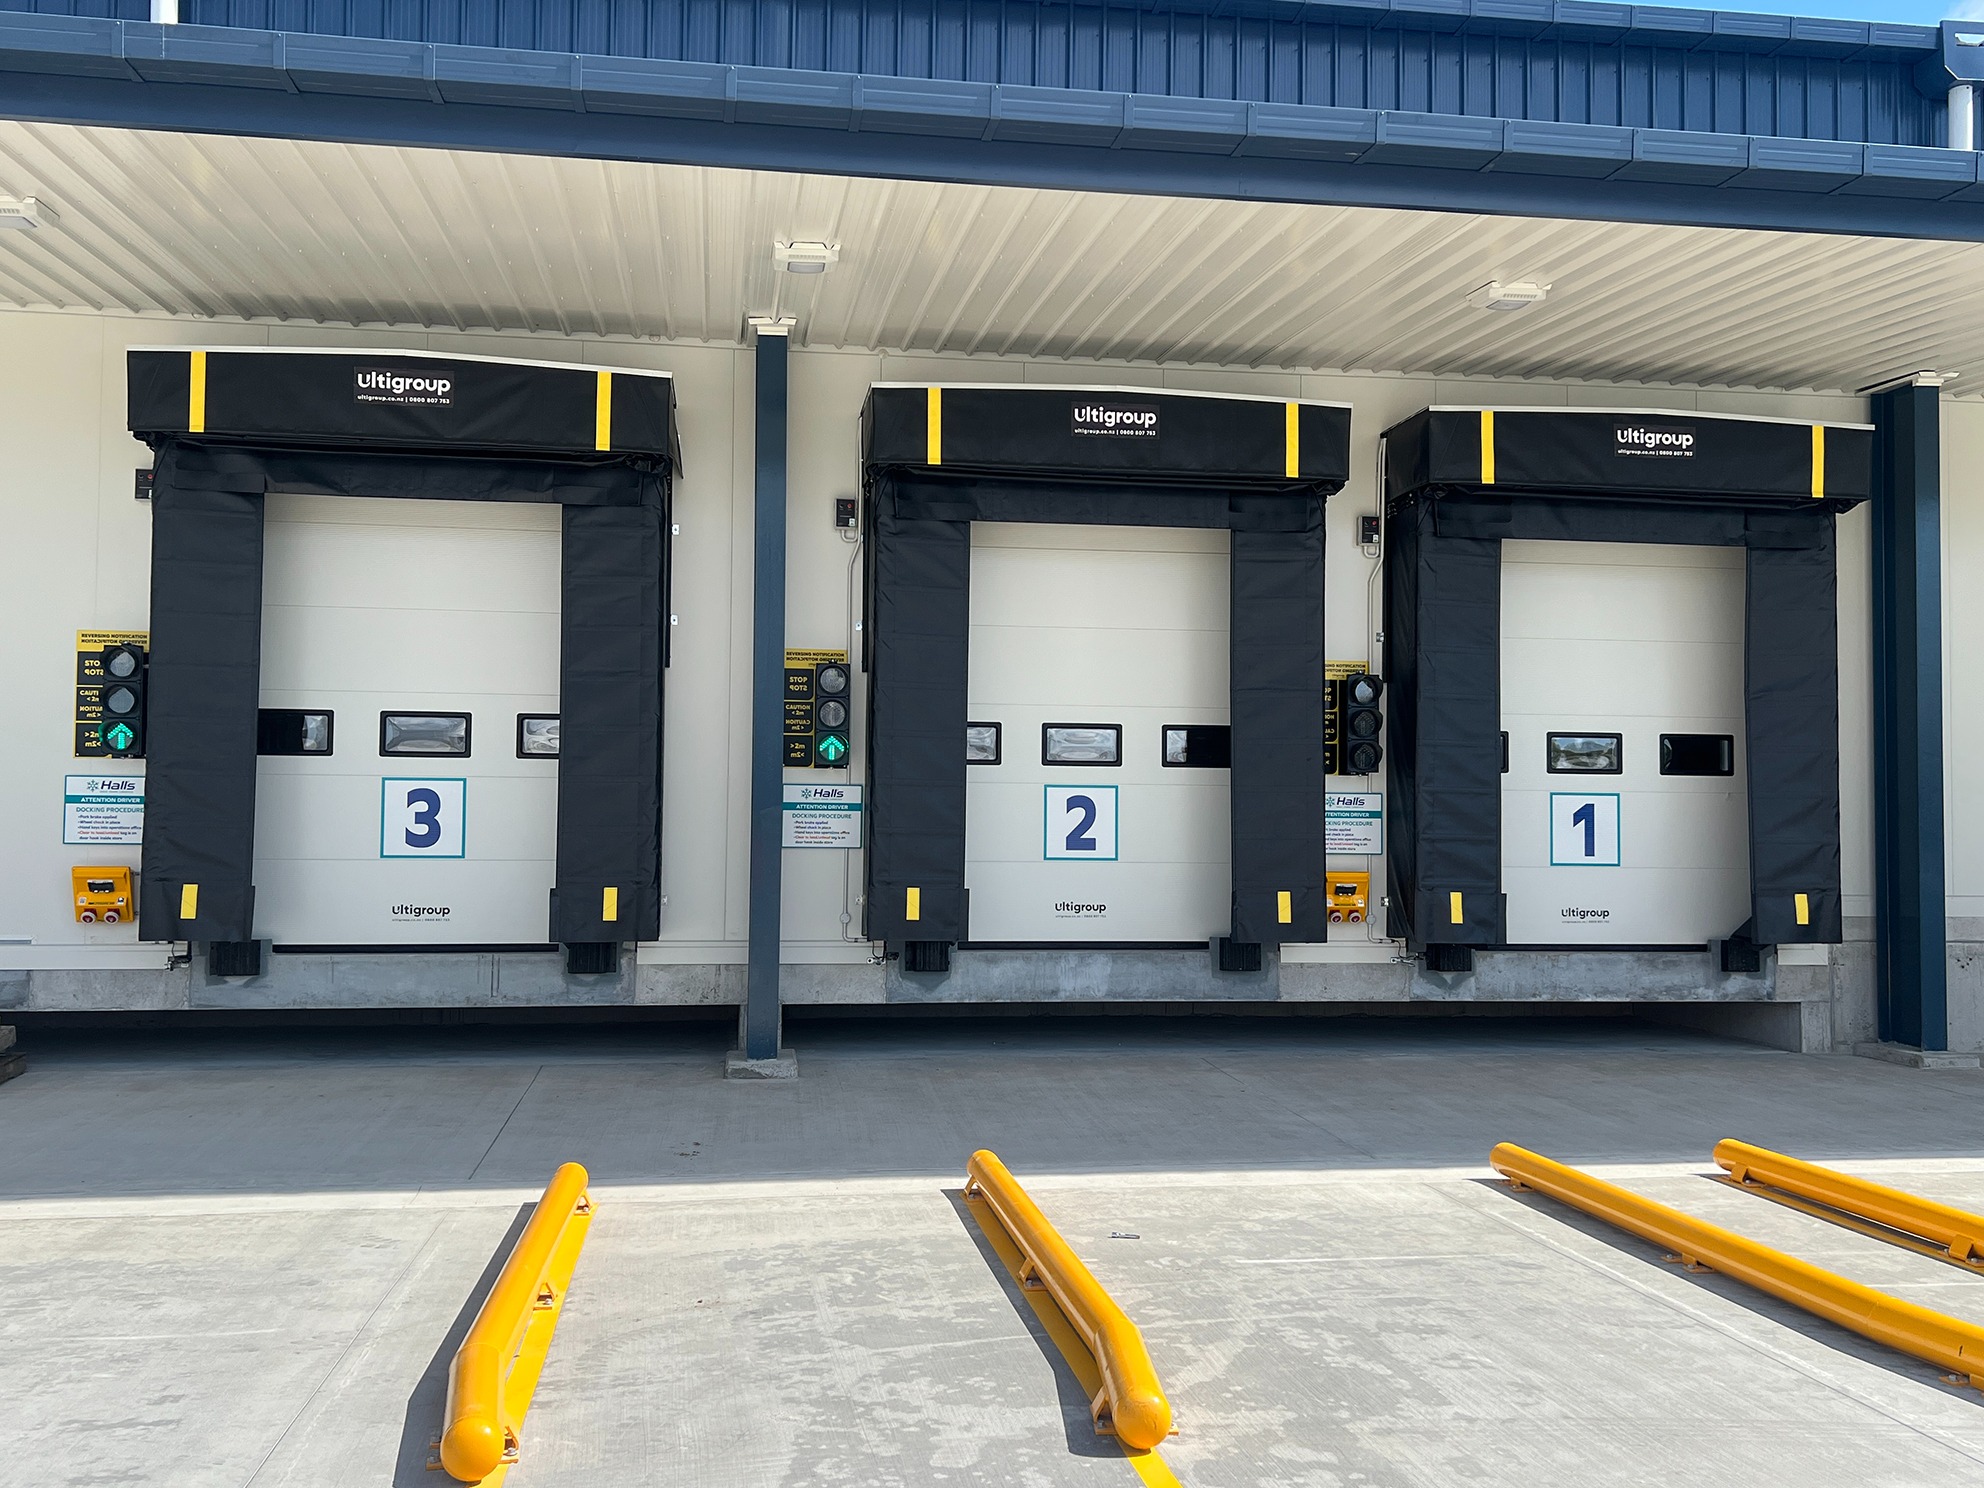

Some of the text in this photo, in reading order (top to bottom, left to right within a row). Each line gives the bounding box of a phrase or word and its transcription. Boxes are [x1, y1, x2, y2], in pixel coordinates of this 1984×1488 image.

[101, 780, 136, 791] Halls
[813, 788, 844, 798] Halls
[1336, 796, 1365, 806] Halls
[405, 788, 441, 848] 3
[1066, 795, 1096, 850] 2
[1573, 803, 1595, 857] 1
